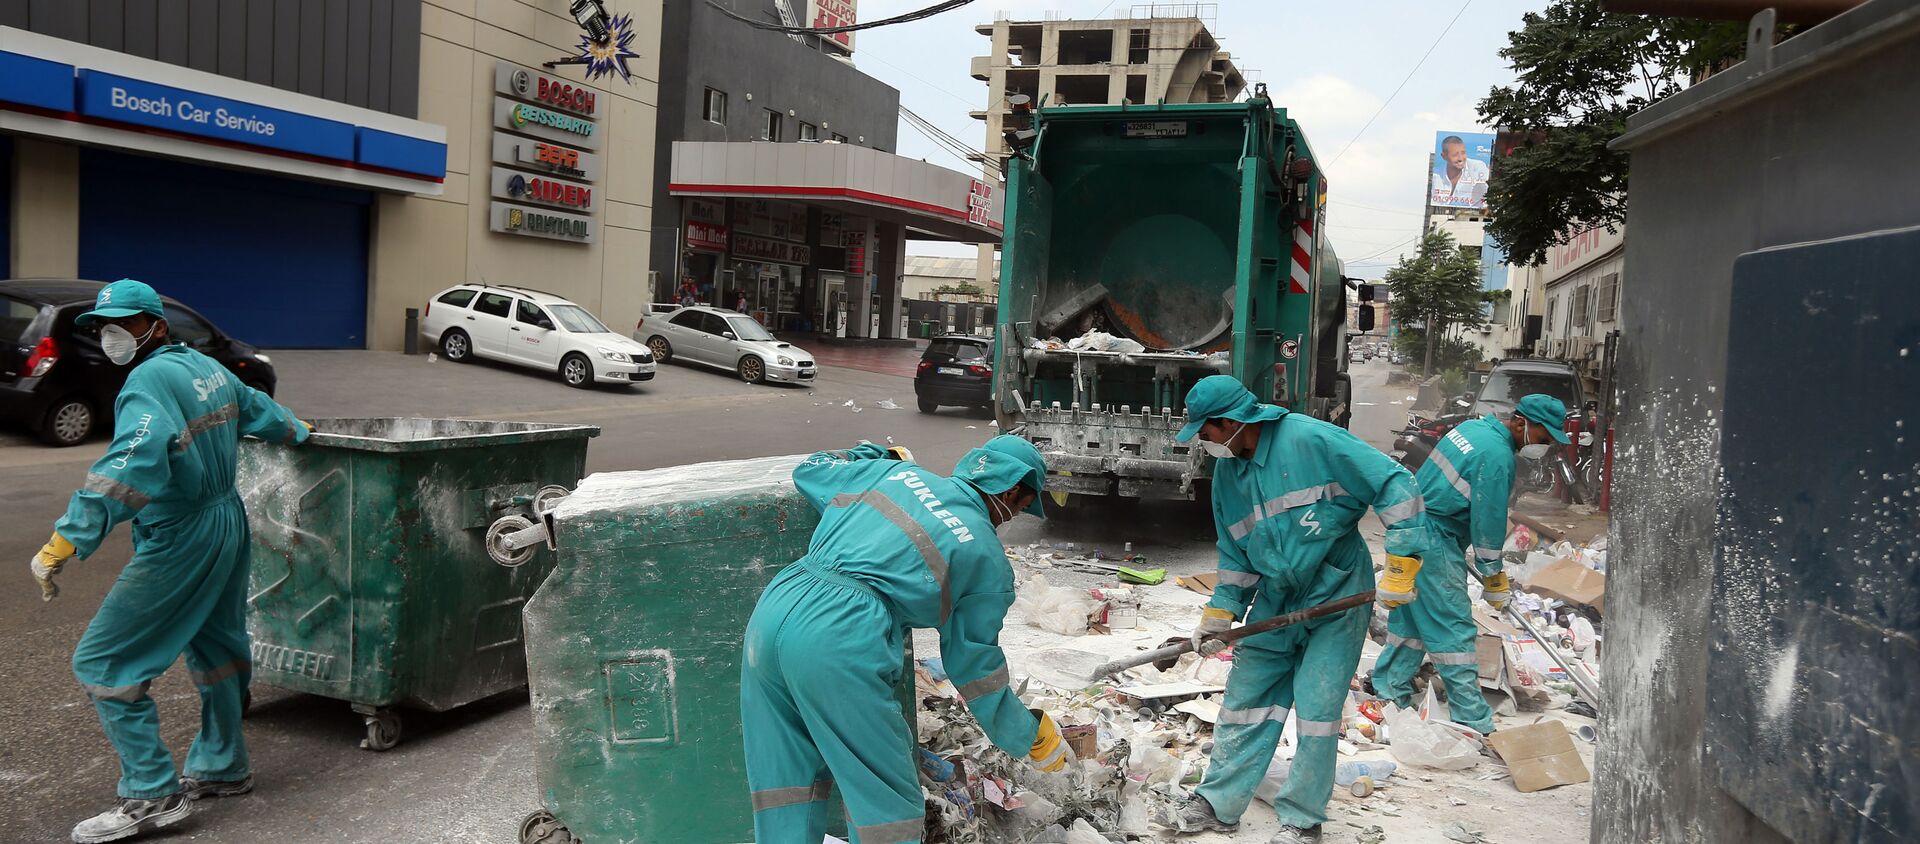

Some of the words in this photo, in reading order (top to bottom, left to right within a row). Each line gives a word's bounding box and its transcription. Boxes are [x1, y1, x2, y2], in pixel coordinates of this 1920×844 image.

[538, 77, 595, 114] BOSCH
[111, 87, 172, 117] Bosch
[177, 101, 211, 124] Car
[215, 108, 275, 136] Service
[520, 104, 594, 136] BEISSBARTH
[536, 143, 580, 168] BEHR
[530, 177, 592, 208] SIDEM
[688, 224, 707, 241] Mini
[708, 228, 728, 246] Mart
[823, 213, 841, 227] 24
[887, 470, 975, 544] SUKLEEN
